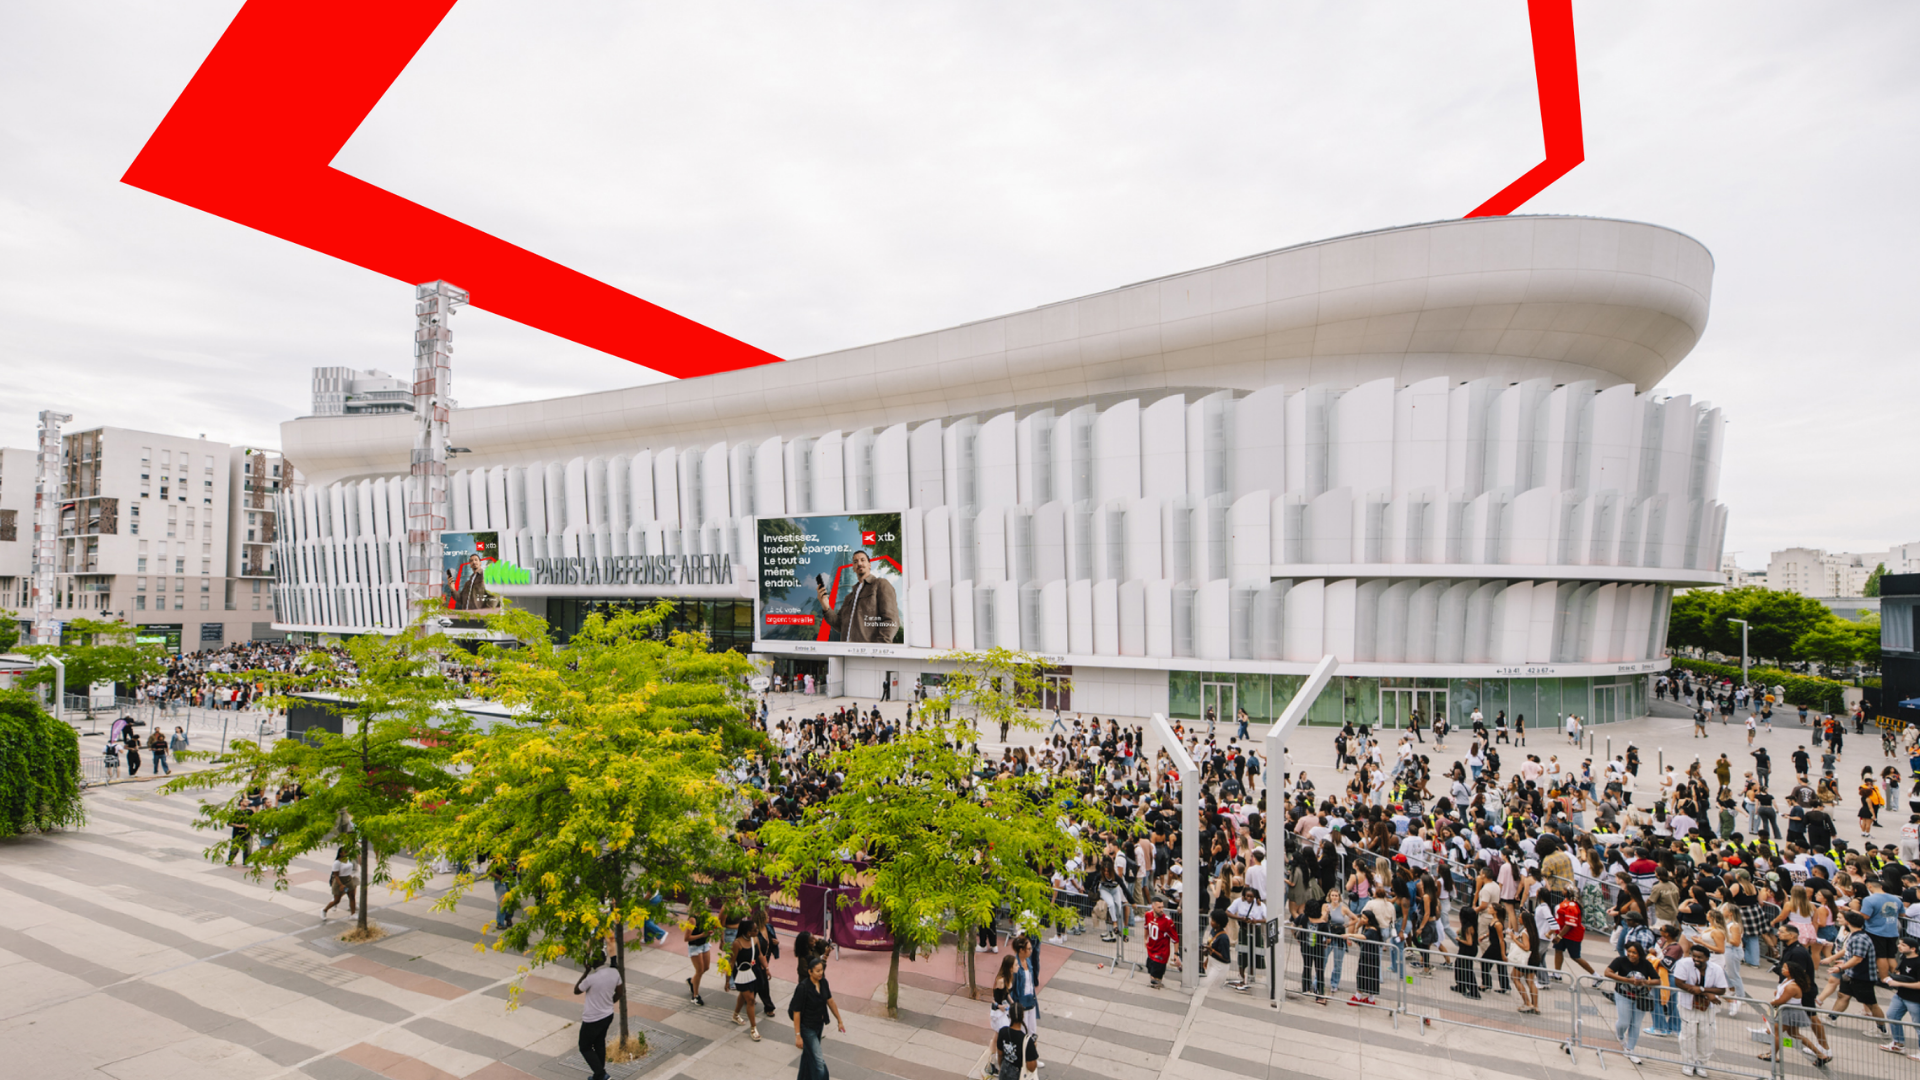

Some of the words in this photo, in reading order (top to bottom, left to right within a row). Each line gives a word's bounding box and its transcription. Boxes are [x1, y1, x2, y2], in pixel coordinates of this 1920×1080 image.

[763, 533, 820, 543] Investissez,
[877, 531, 896, 542] xtb
[802, 544, 852, 555] épargnez.
[763, 557, 776, 565] Le
[777, 557, 797, 565] tout
[798, 557, 811, 565] au
[534, 556, 579, 585] PARIS
[579, 556, 600, 585] LA
[602, 555, 676, 585] DEFENSE
[679, 553, 733, 585] ARENA
[763, 567, 795, 576] même
[764, 577, 802, 587] endroit.
[766, 616, 788, 624] argent
[788, 616, 814, 624] travaille
[653, 628, 663, 637] 33
[1148, 923, 1159, 941] 10
